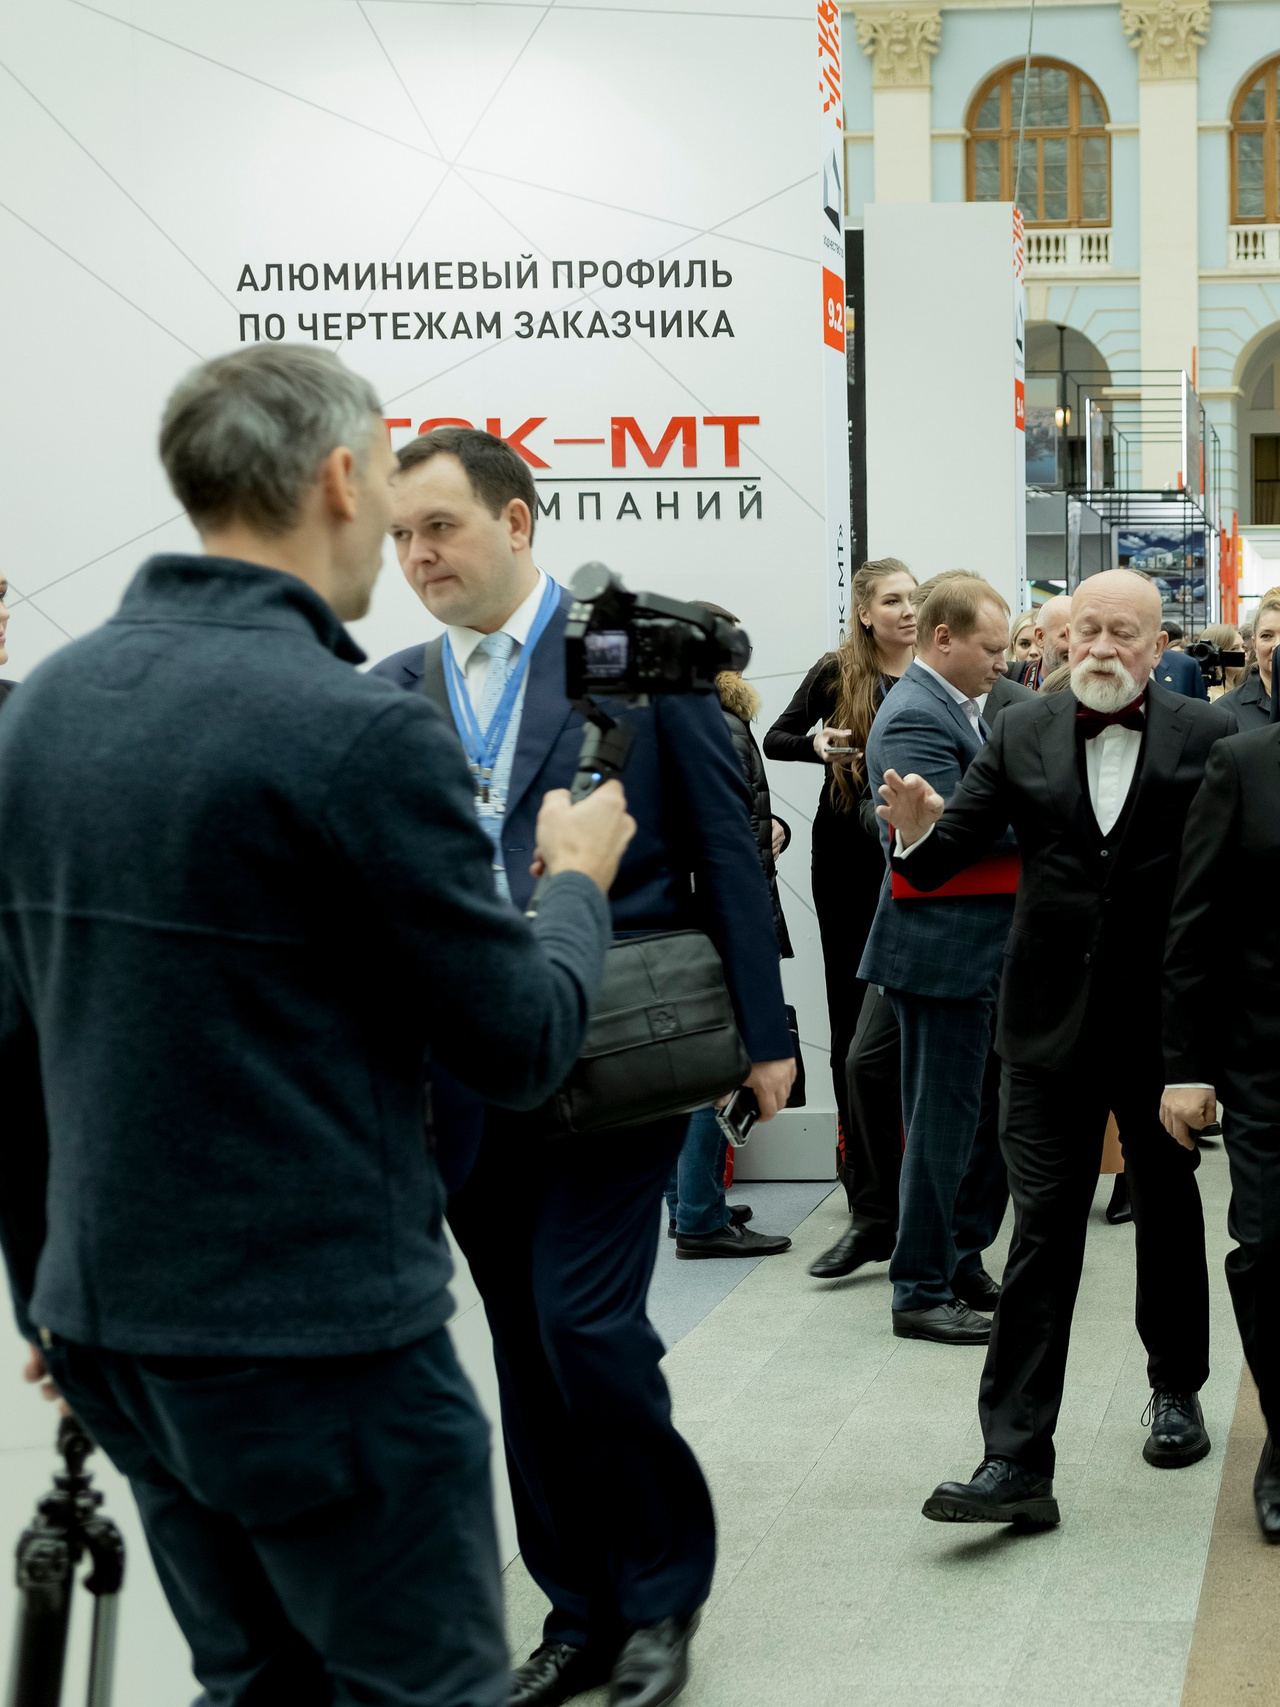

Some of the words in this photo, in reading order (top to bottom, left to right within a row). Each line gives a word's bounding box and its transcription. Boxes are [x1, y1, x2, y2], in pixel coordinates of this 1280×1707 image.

[237, 254, 538, 291] АЛЮМИНИЕВЫЙ
[552, 259, 732, 288] ПРОФИЛЬ
[240, 314, 285, 341] ПО
[298, 312, 501, 340] ЧЕРТЕЖАМ
[514, 310, 735, 339] ЗАКАЗЧИКА
[828, 297, 843, 333] 9.2
[536, 484, 763, 520] МПАНИЙ
